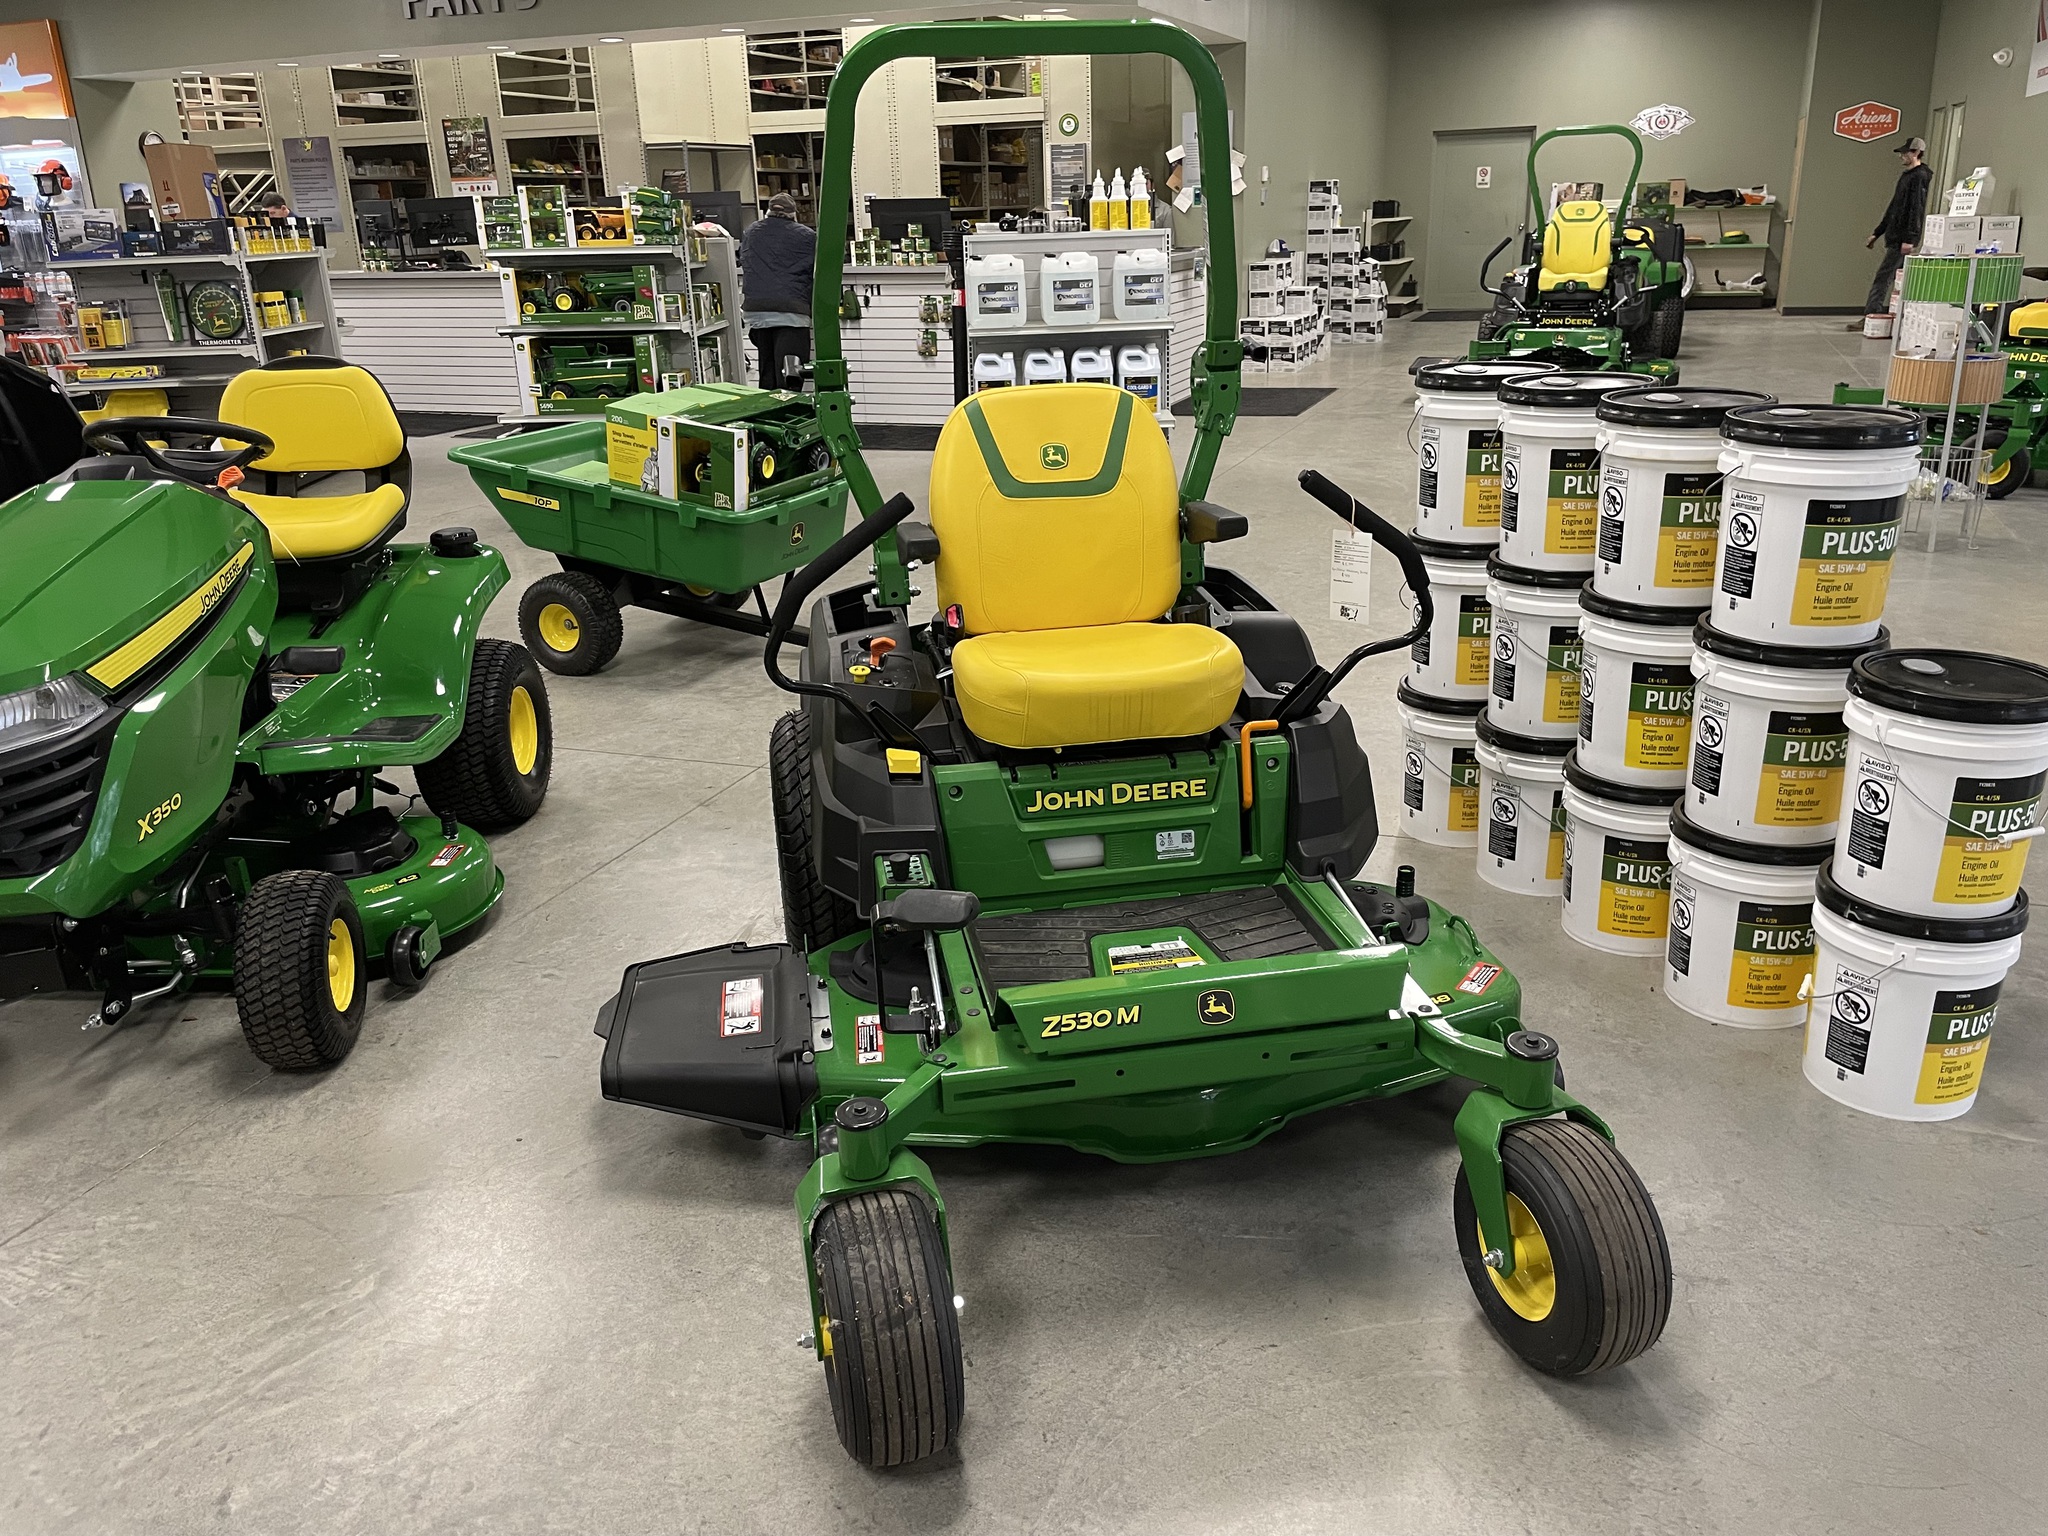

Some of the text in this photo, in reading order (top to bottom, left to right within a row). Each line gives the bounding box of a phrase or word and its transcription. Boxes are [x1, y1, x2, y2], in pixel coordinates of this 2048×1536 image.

[1841, 107, 1892, 125] Ariens
[1150, 276, 1164, 284] DEF
[1004, 284, 1018, 292] DEF
[1540, 318, 1594, 326] JOHN DEERE
[2010, 352, 2028, 362] HN
[611, 415, 623, 424] 200
[612, 430, 636, 440] Shop Towels
[1480, 454, 1500, 472] PL
[1480, 478, 1492, 486] SAE
[534, 497, 552, 507] 10P
[1479, 493, 1498, 502] Engine
[1740, 494, 1758, 502] AVISO
[1562, 502, 1576, 510] SAE
[1562, 518, 1582, 526] Engine
[1560, 528, 1576, 536] Huile
[1676, 531, 1692, 540] SAE
[1822, 526, 1894, 555] PLUS-50
[782, 544, 810, 560] JOHN DEERE
[1675, 548, 1710, 558] Engine Oil
[1674, 560, 1715, 568] Huile moteur
[1818, 562, 1866, 574] SAE 15W-40
[200, 558, 241, 615] JOHN DEERE
[1816, 582, 1854, 594] Engine Oil
[1813, 596, 1859, 604] Huile moteur
[1472, 640, 1483, 648] SAE
[1470, 654, 1490, 662] Engine
[1708, 697, 1724, 708] AVISO
[1643, 716, 1685, 726] SAE 15W-40
[1642, 732, 1674, 742] Engine Oil
[1640, 744, 1680, 752] Huile moteur
[1871, 760, 1890, 771] AVISO
[1780, 769, 1827, 778] SAE 15W-40
[1027, 778, 1207, 813] JOHN DEERE
[1778, 786, 1815, 797] Engine Oil
[1776, 798, 1820, 807] Huile moteur
[1976, 794, 2001, 802] CK-4/SN
[137, 792, 182, 844] X350
[1970, 800, 2040, 833] PLUS-50
[1965, 842, 1982, 852] SAE
[1962, 860, 2000, 871] Engine Oil
[398, 874, 418, 884] 42
[1958, 873, 2004, 882] Huile moteur
[1615, 886, 1655, 898] SAE 15W-40
[1614, 902, 1644, 912] Engine Oil
[1612, 911, 1628, 920] Huile
[1629, 914, 1651, 922] moteur
[1752, 928, 1815, 950] PLUS-5
[1750, 956, 1793, 966] SAE 15W-40
[1748, 972, 1782, 982] Engine Oil
[1746, 982, 1764, 991] Huile
[1041, 1005, 1141, 1038] Z530 M
[1943, 1047, 1959, 1056] SAE
[1940, 1062, 1972, 1074] Engine Oil
[1938, 1076, 1954, 1085] Huile
